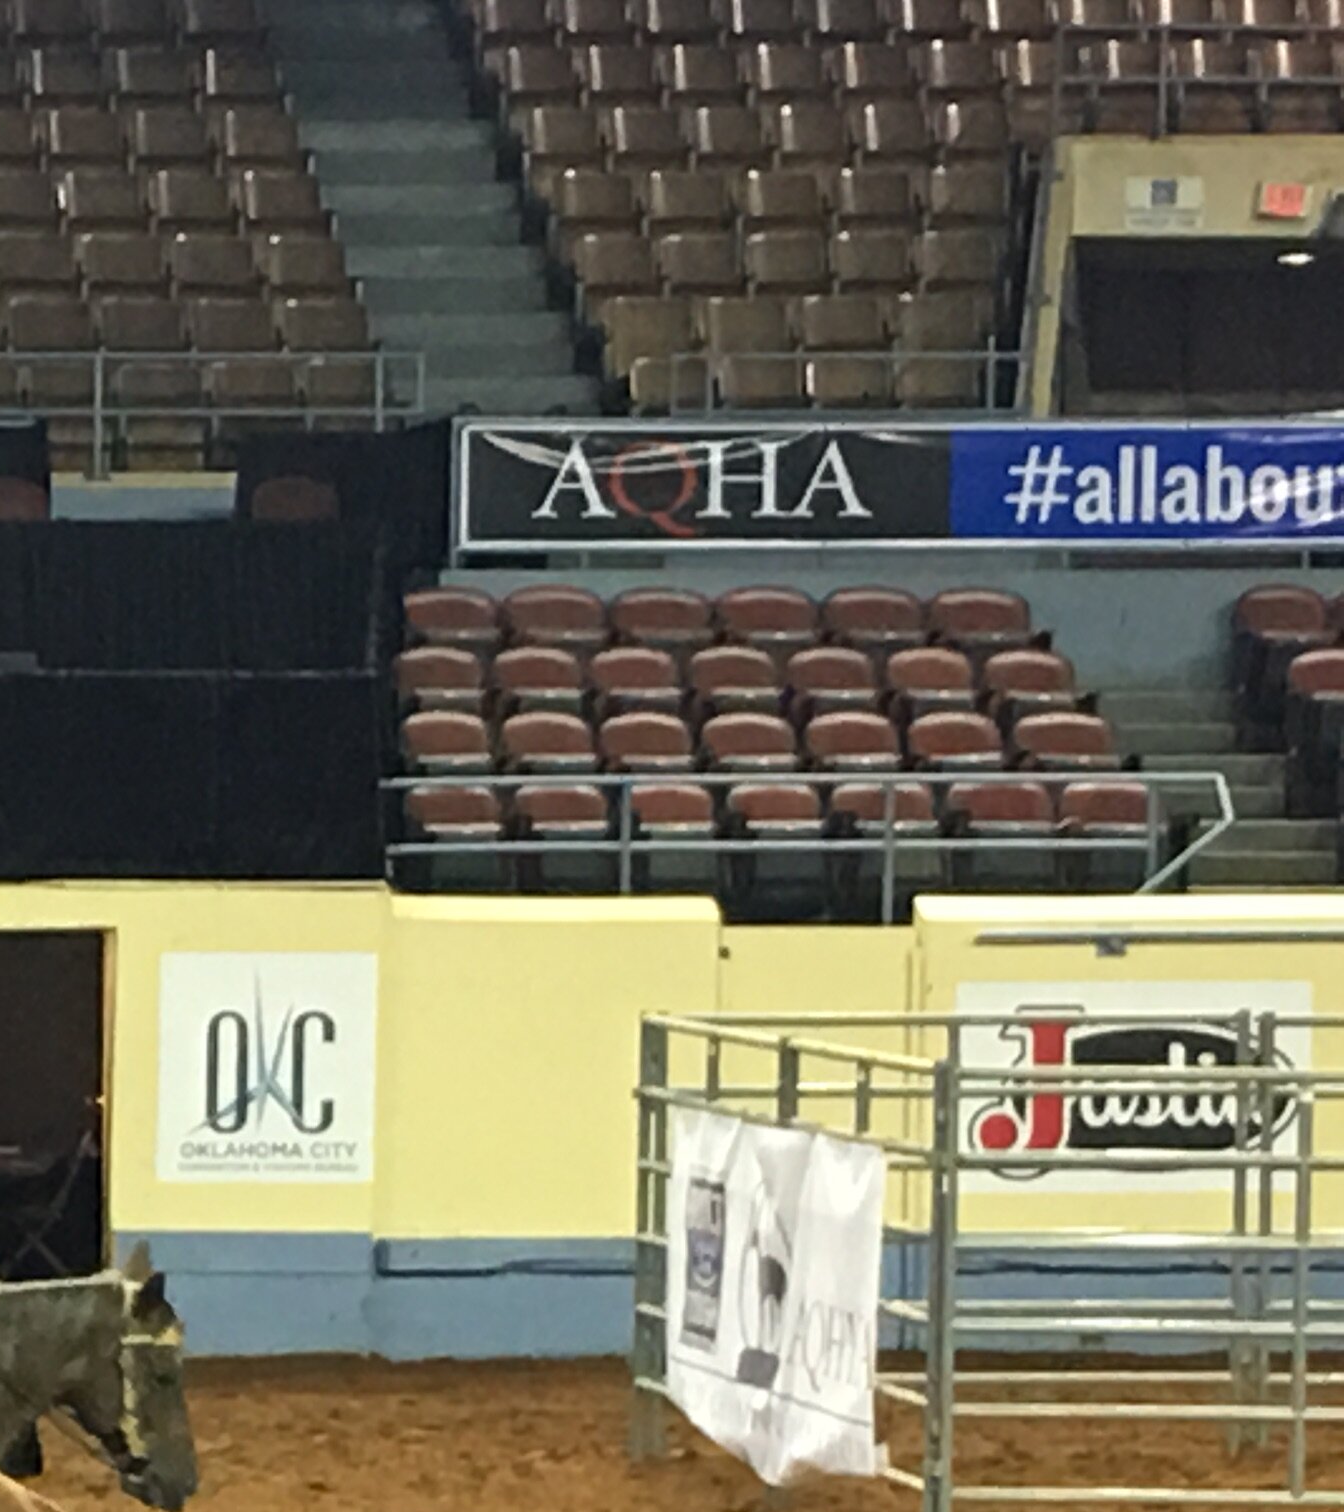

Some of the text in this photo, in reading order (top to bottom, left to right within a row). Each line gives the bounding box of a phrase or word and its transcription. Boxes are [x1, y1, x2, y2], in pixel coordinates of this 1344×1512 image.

[530, 438, 874, 537] AQHA
[179, 1141, 358, 1160] OKLAHOMA CITY
